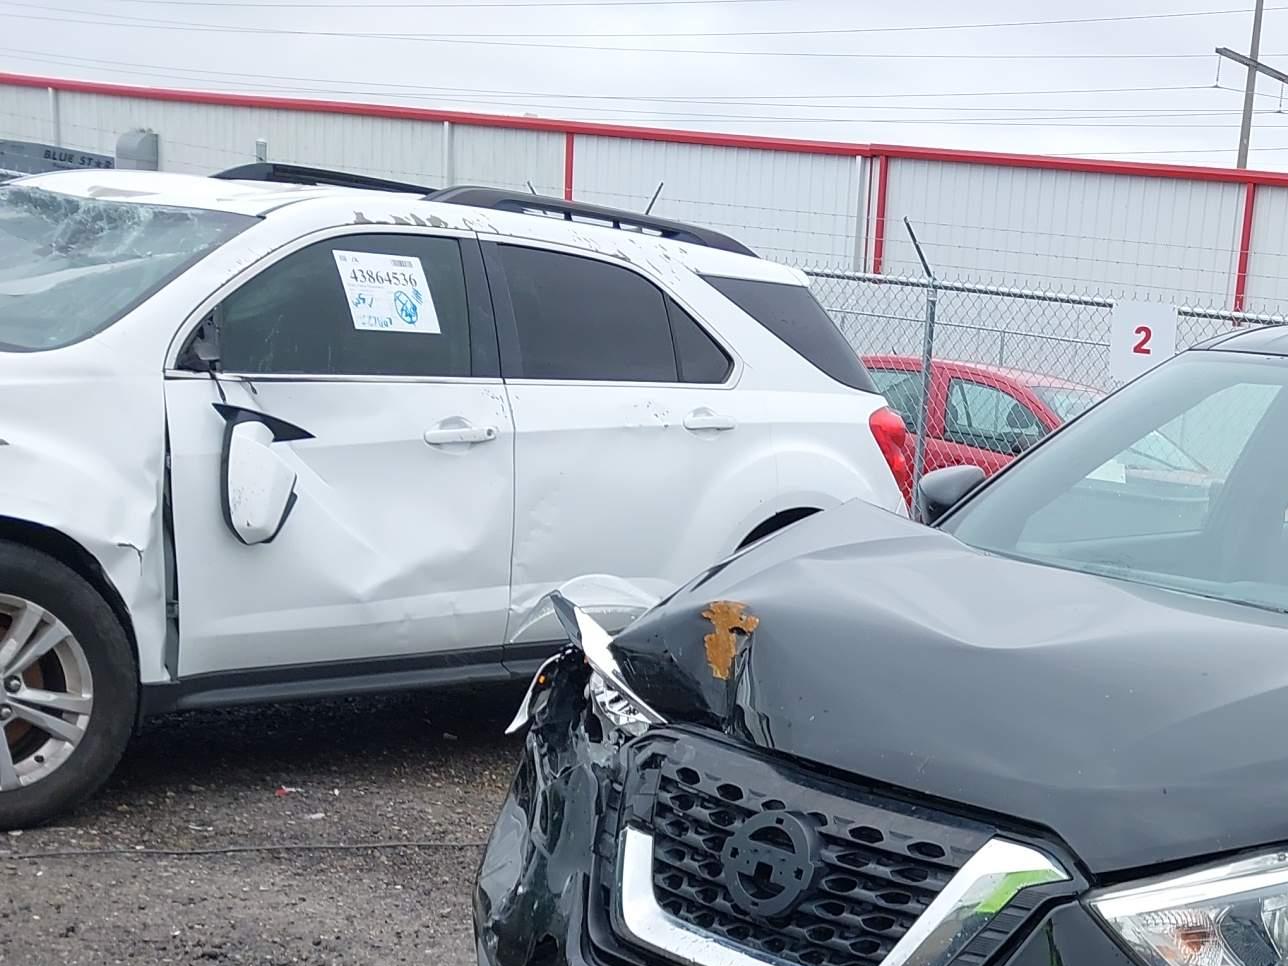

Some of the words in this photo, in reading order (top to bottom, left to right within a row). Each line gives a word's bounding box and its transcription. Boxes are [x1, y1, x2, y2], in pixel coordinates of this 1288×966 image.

[44, 149, 73, 163] BLUE
[350, 269, 417, 287] 43864536
[1133, 326, 1152, 354] 2
